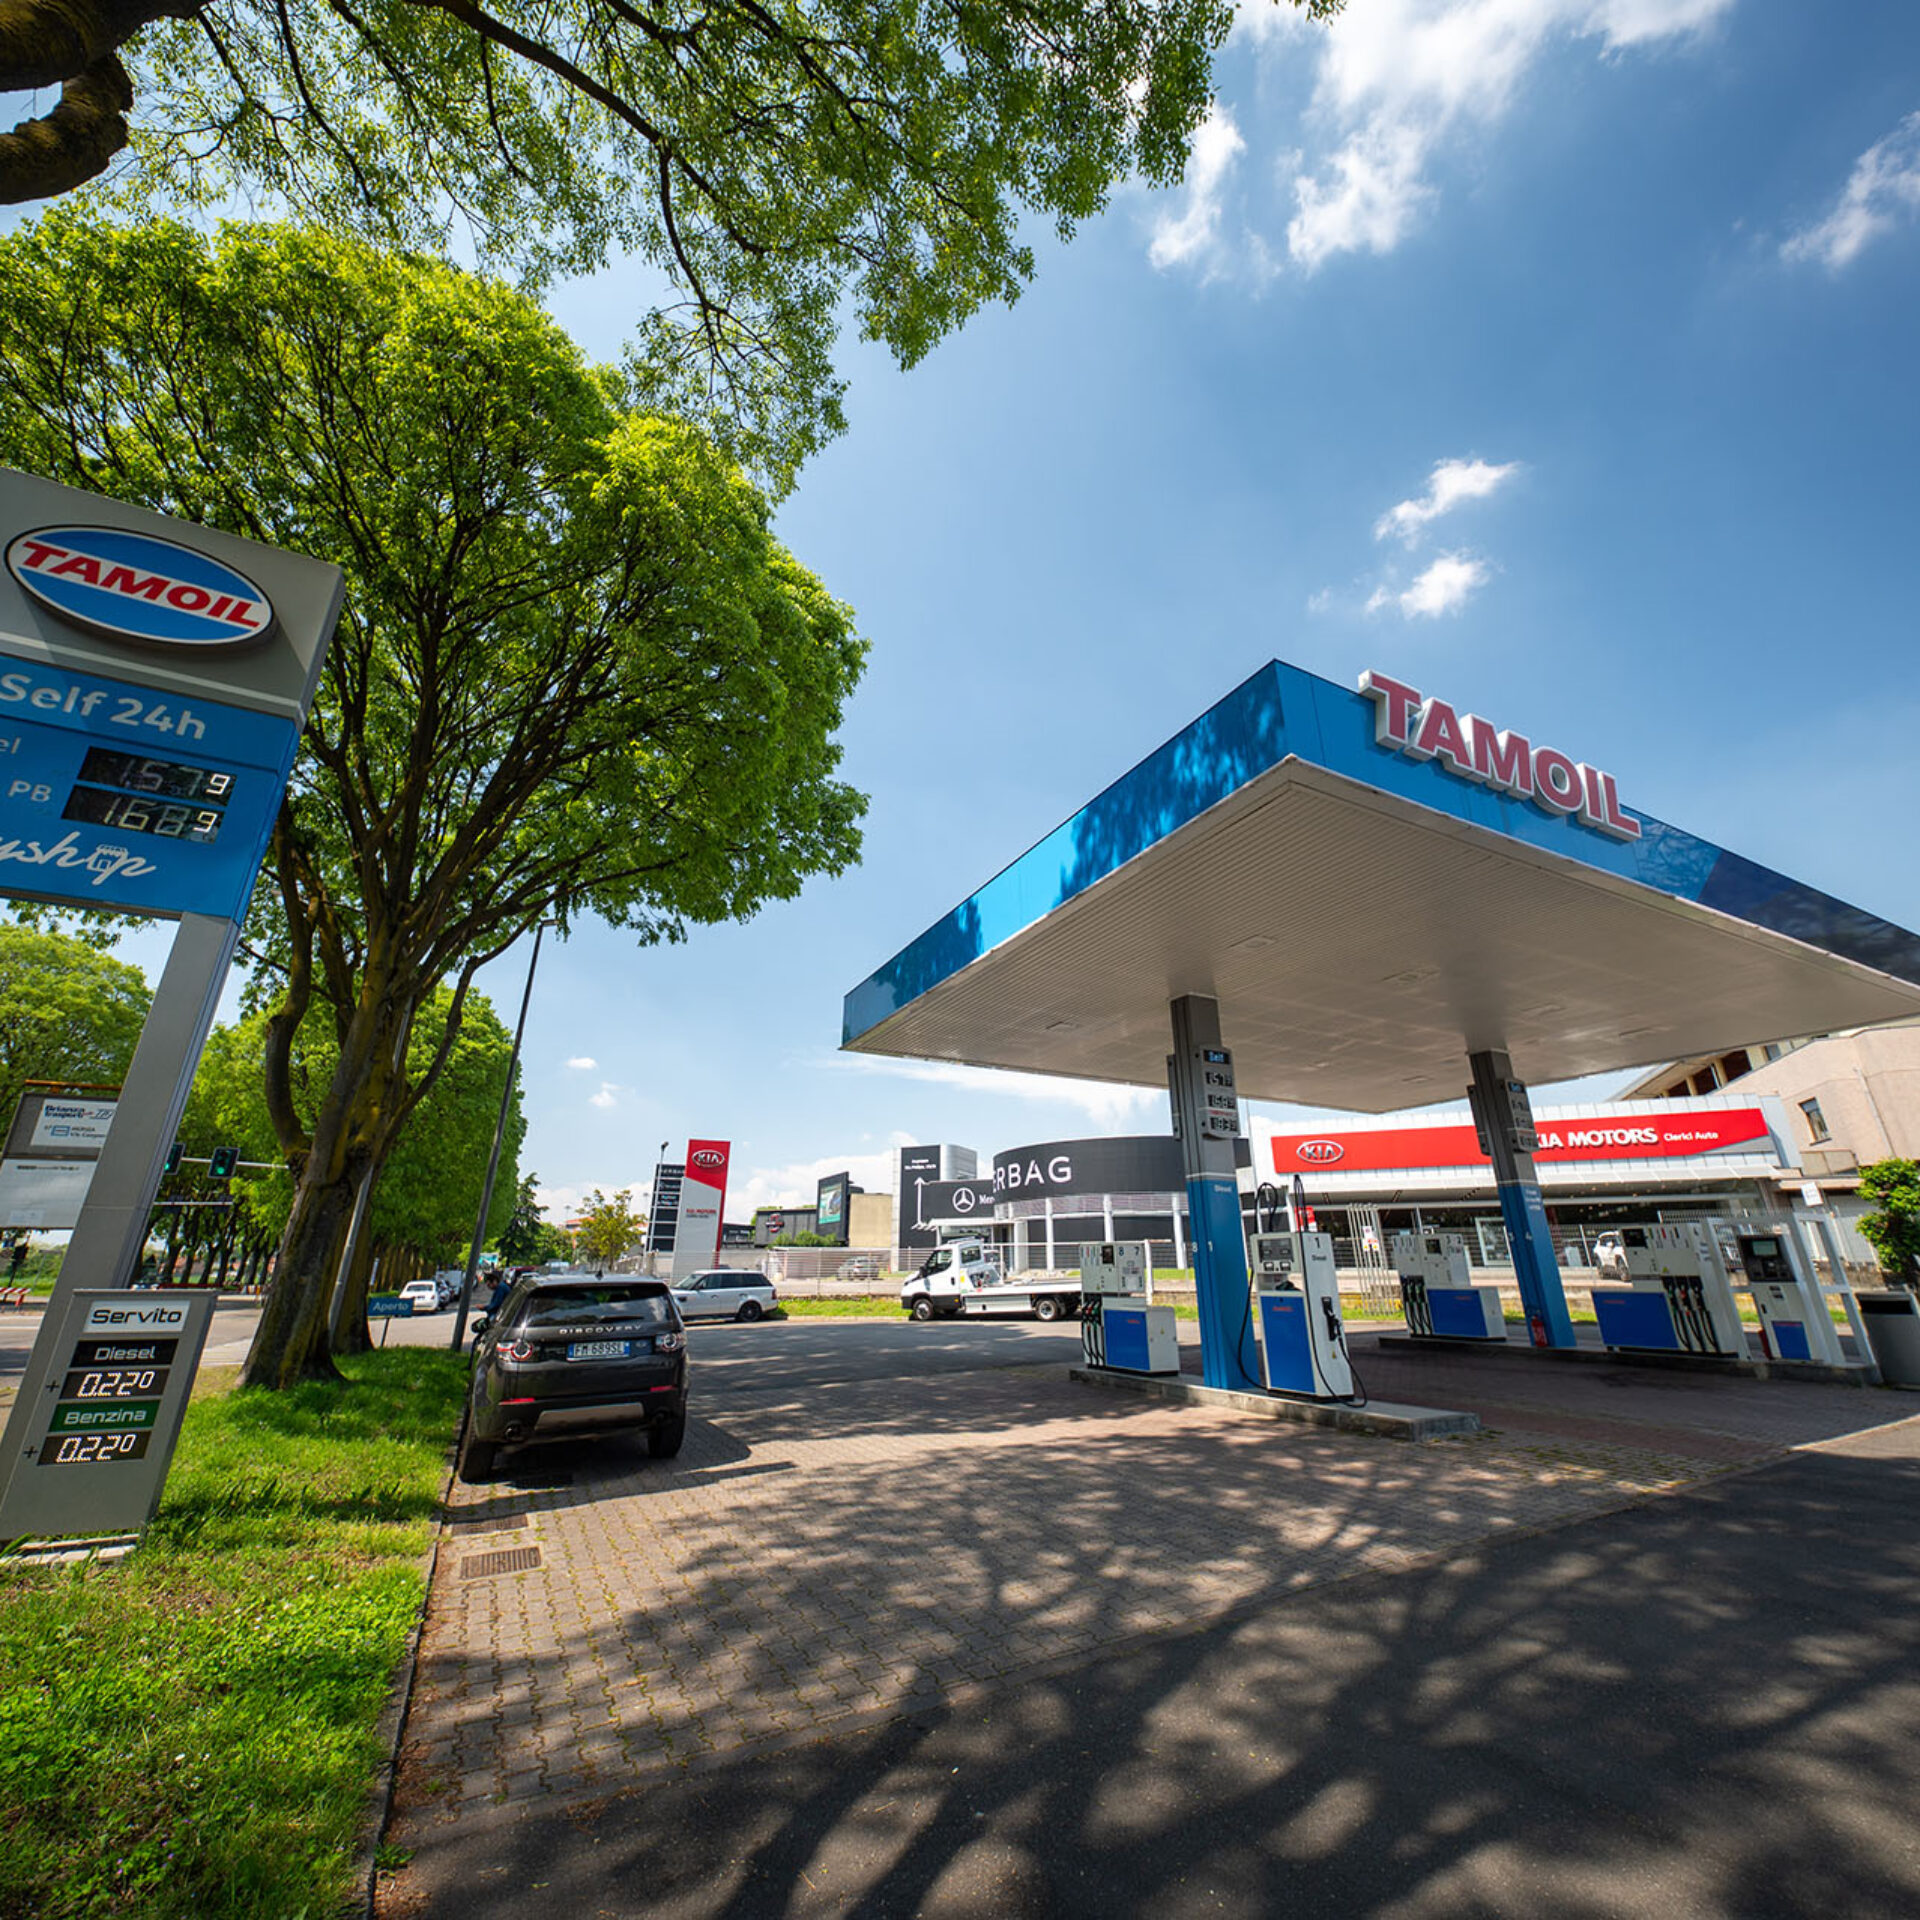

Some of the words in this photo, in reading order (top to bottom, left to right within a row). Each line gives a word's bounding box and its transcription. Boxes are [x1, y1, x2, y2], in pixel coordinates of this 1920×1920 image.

[23, 542, 260, 628] TAMOIL
[0, 674, 107, 716] Self
[110, 698, 205, 739] 24h
[1359, 669, 1642, 841] TAMOIL
[8, 780, 51, 802] PB
[1568, 1127, 1658, 1147] MOTORS
[1695, 1131, 1719, 1140] Auto
[698, 1153, 719, 1163] KIA
[1305, 1144, 1336, 1160] KIA
[91, 1307, 182, 1324] Servito
[372, 1301, 409, 1313] Aperto
[559, 1324, 642, 1335] DISCOVERY
[94, 1345, 156, 1361] Diesel
[64, 1408, 147, 1425] Benzina
